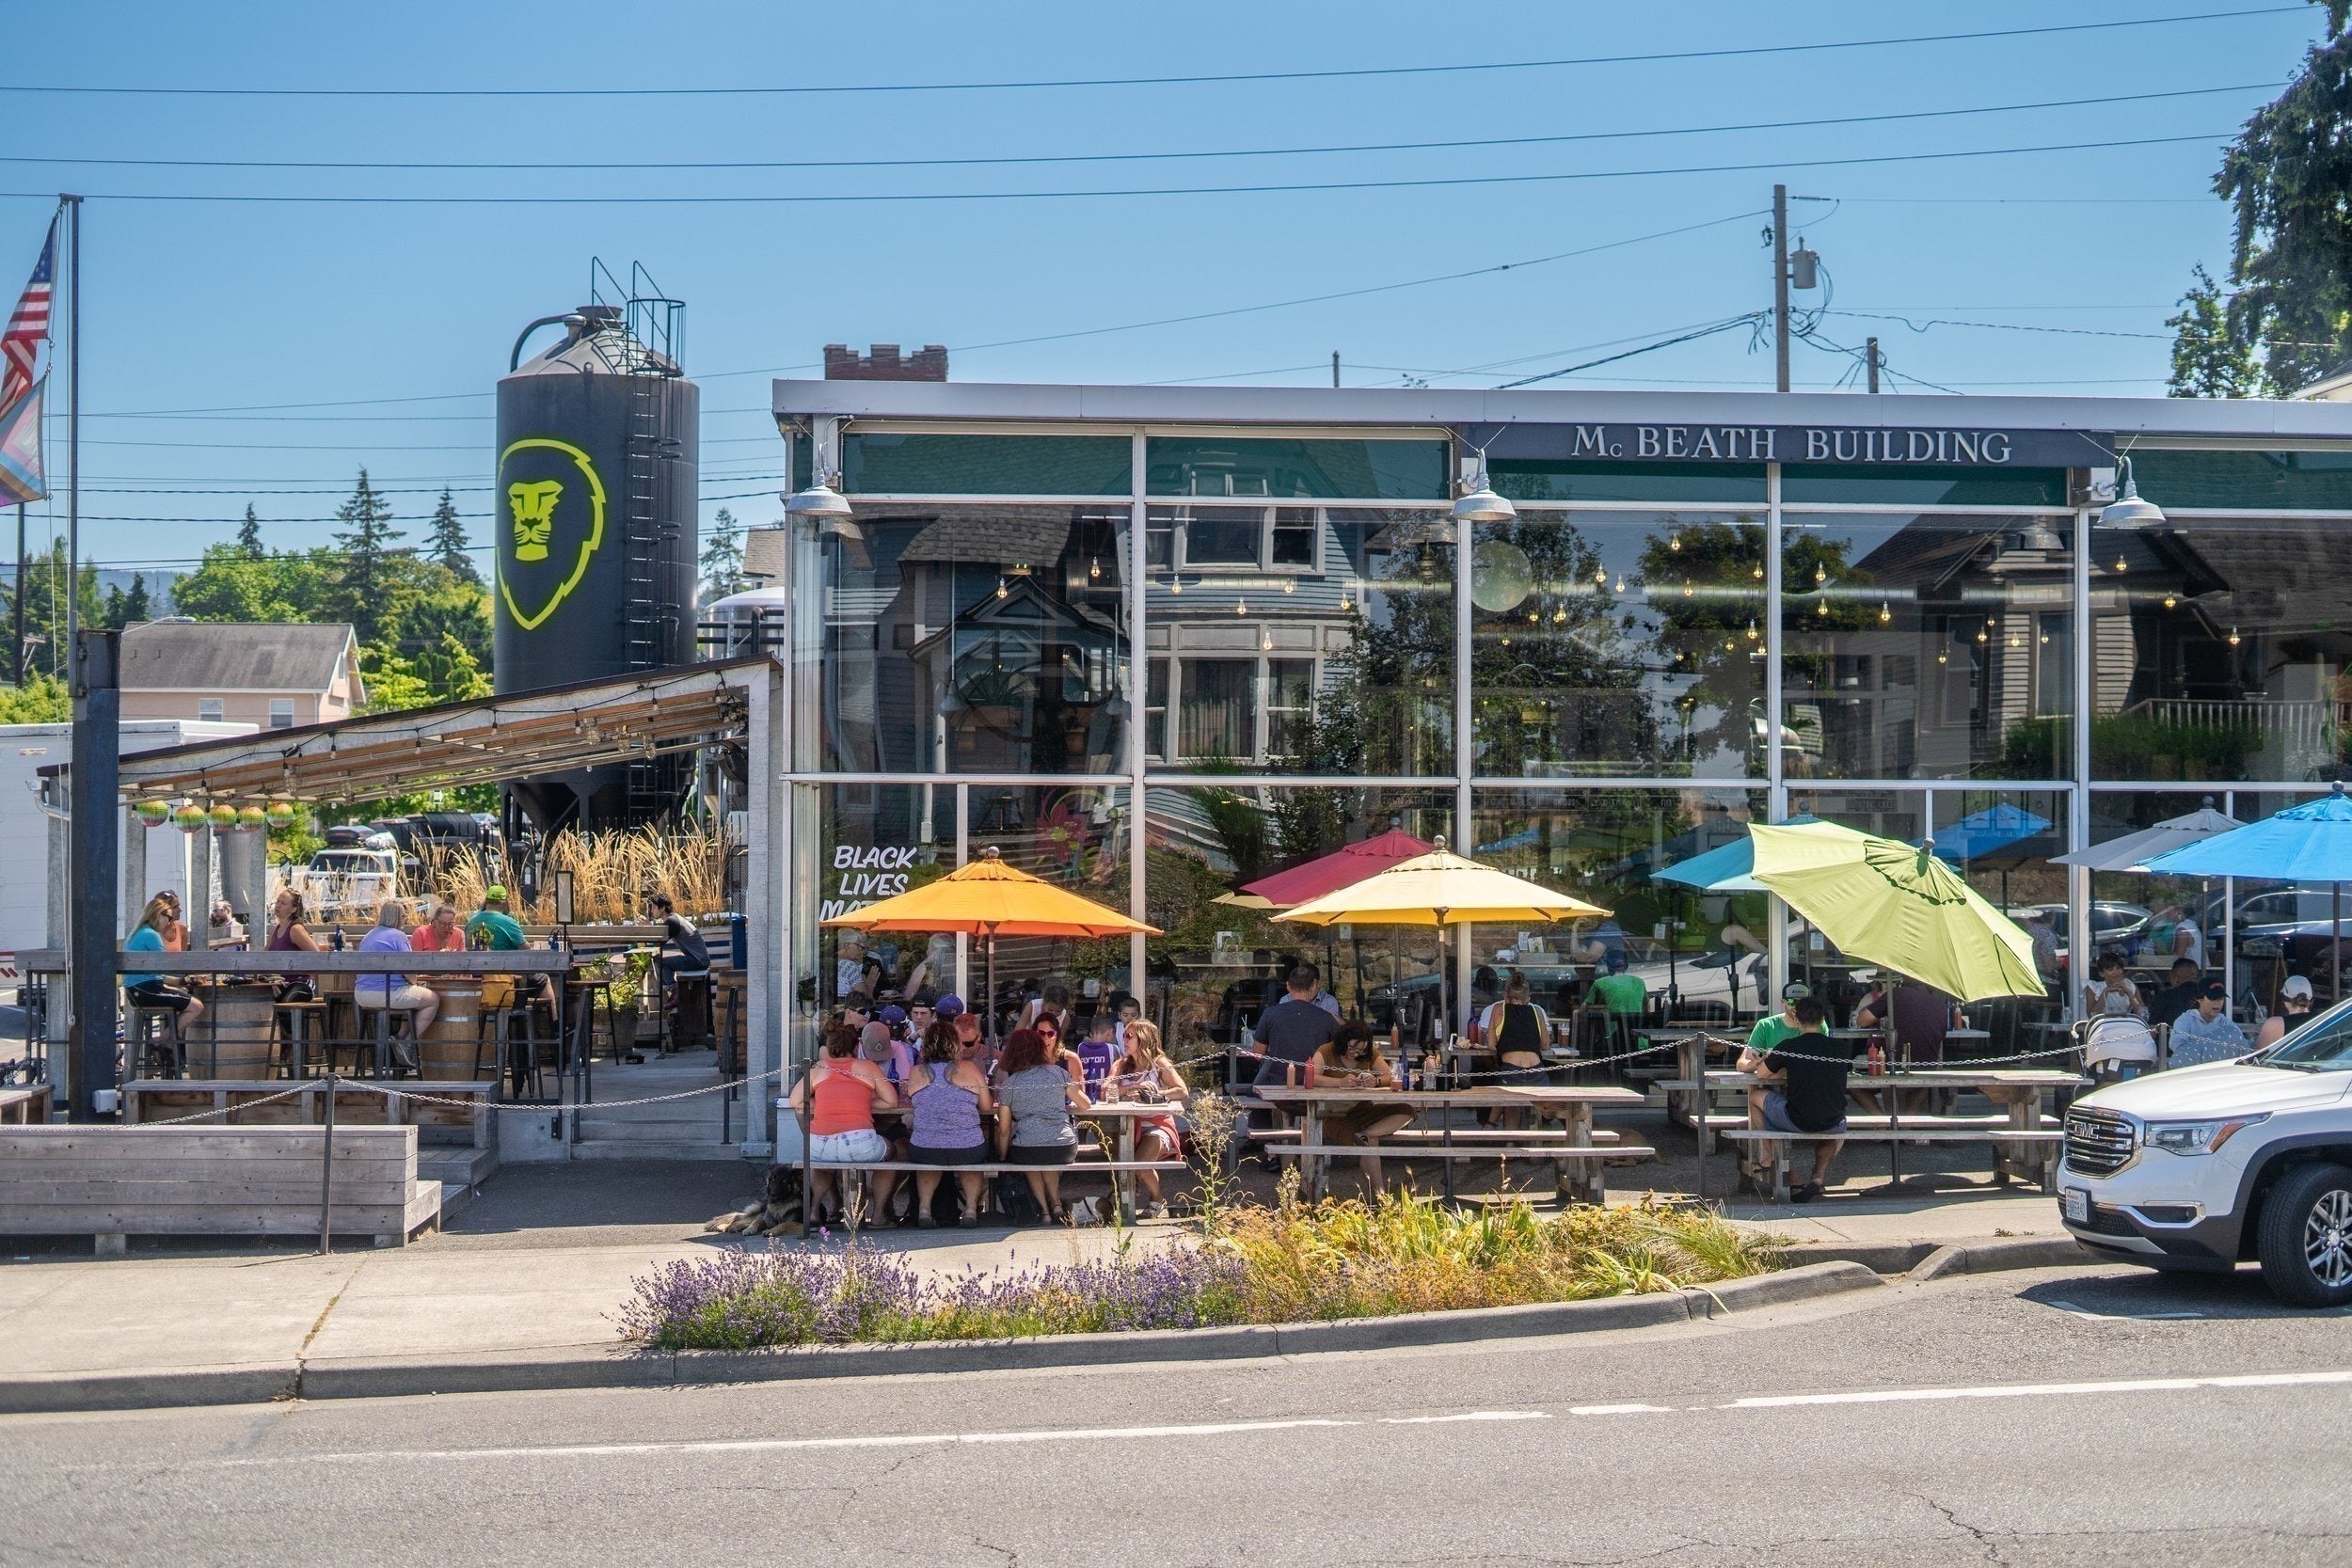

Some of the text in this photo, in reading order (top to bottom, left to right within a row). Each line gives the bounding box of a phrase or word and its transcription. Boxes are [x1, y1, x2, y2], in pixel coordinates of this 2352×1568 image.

[1571, 425, 2012, 464] Mc BEATH BUILDING
[834, 845, 917, 869] BLACK
[839, 872, 909, 896] LIVES
[2074, 1122, 2100, 1140] GMC
